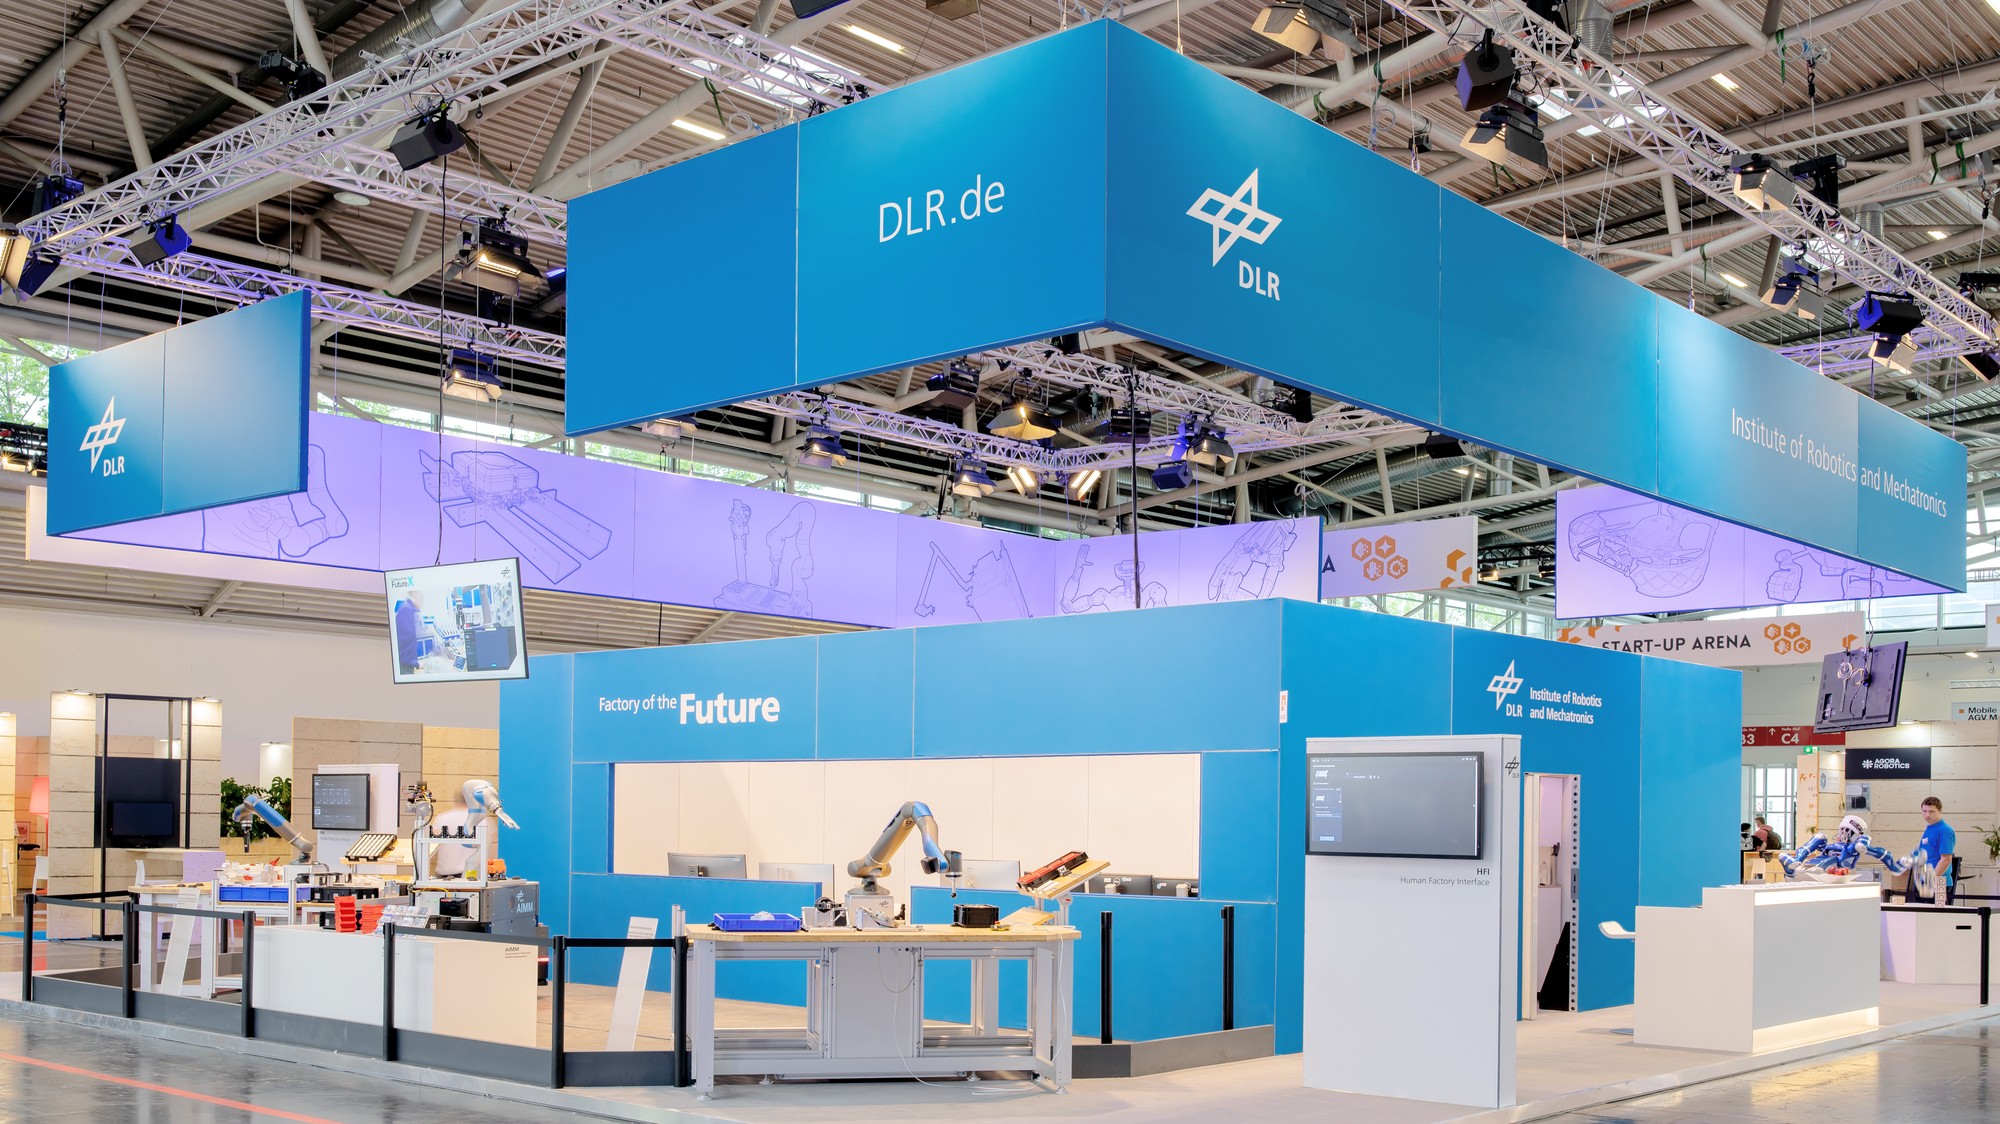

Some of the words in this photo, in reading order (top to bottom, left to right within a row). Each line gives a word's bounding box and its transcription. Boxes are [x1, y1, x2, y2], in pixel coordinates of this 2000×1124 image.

[879, 174, 1005, 243] DLR.de
[1239, 260, 1280, 301] DLR
[103, 455, 125, 477] DLR
[1732, 407, 1786, 454] Institute
[1790, 434, 1803, 460] of
[1807, 439, 1857, 482] Robotics
[1860, 466, 1881, 491] and
[1884, 471, 1947, 518] Mechatronics
[1602, 638, 1686, 653] START-UP
[1692, 634, 1751, 650] ARENA
[1530, 687, 1561, 703] Institute
[1562, 690, 1572, 704] of
[1572, 692, 1602, 707] Robotics
[599, 697, 640, 715] Factory
[642, 694, 656, 710] of
[657, 693, 677, 710] the
[680, 692, 780, 725] Future
[1506, 703, 1523, 718] DLR
[1529, 706, 1545, 719] and
[1546, 707, 1594, 725] Mechatronics
[1781, 733, 1800, 744] C4
[1400, 876, 1426, 884] Human
[1428, 877, 1455, 886] Factory
[1457, 878, 1490, 886] Interface
[1476, 868, 1490, 876] HFI
[516, 902, 534, 914] AIMM
